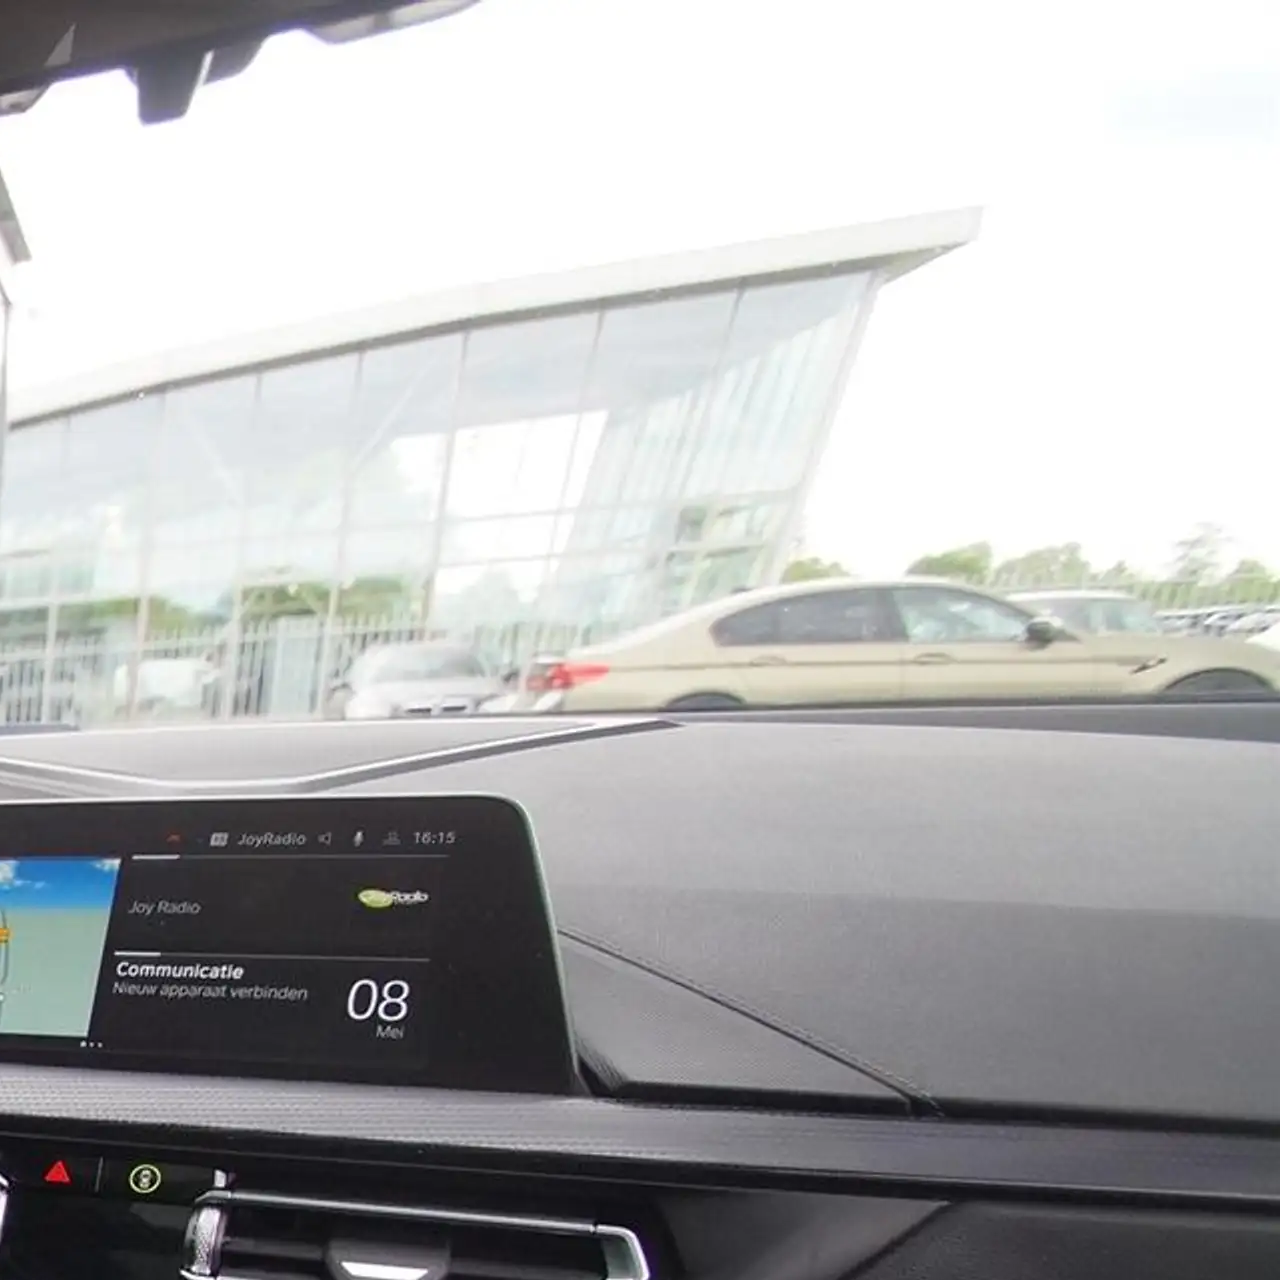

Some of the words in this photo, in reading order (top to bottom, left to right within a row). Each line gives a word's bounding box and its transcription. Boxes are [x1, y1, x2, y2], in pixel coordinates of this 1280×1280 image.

[238, 832, 307, 847] JoyRadio
[413, 831, 456, 845] 16:15
[128, 901, 153, 914] Joy
[156, 901, 201, 914] Radio
[116, 961, 245, 981] Communicatie
[112, 982, 158, 997] Nieuw
[160, 985, 228, 1001] apparaat
[230, 985, 309, 1002] verbinden
[346, 979, 411, 1022] 08
[376, 1025, 405, 1039] Mei
